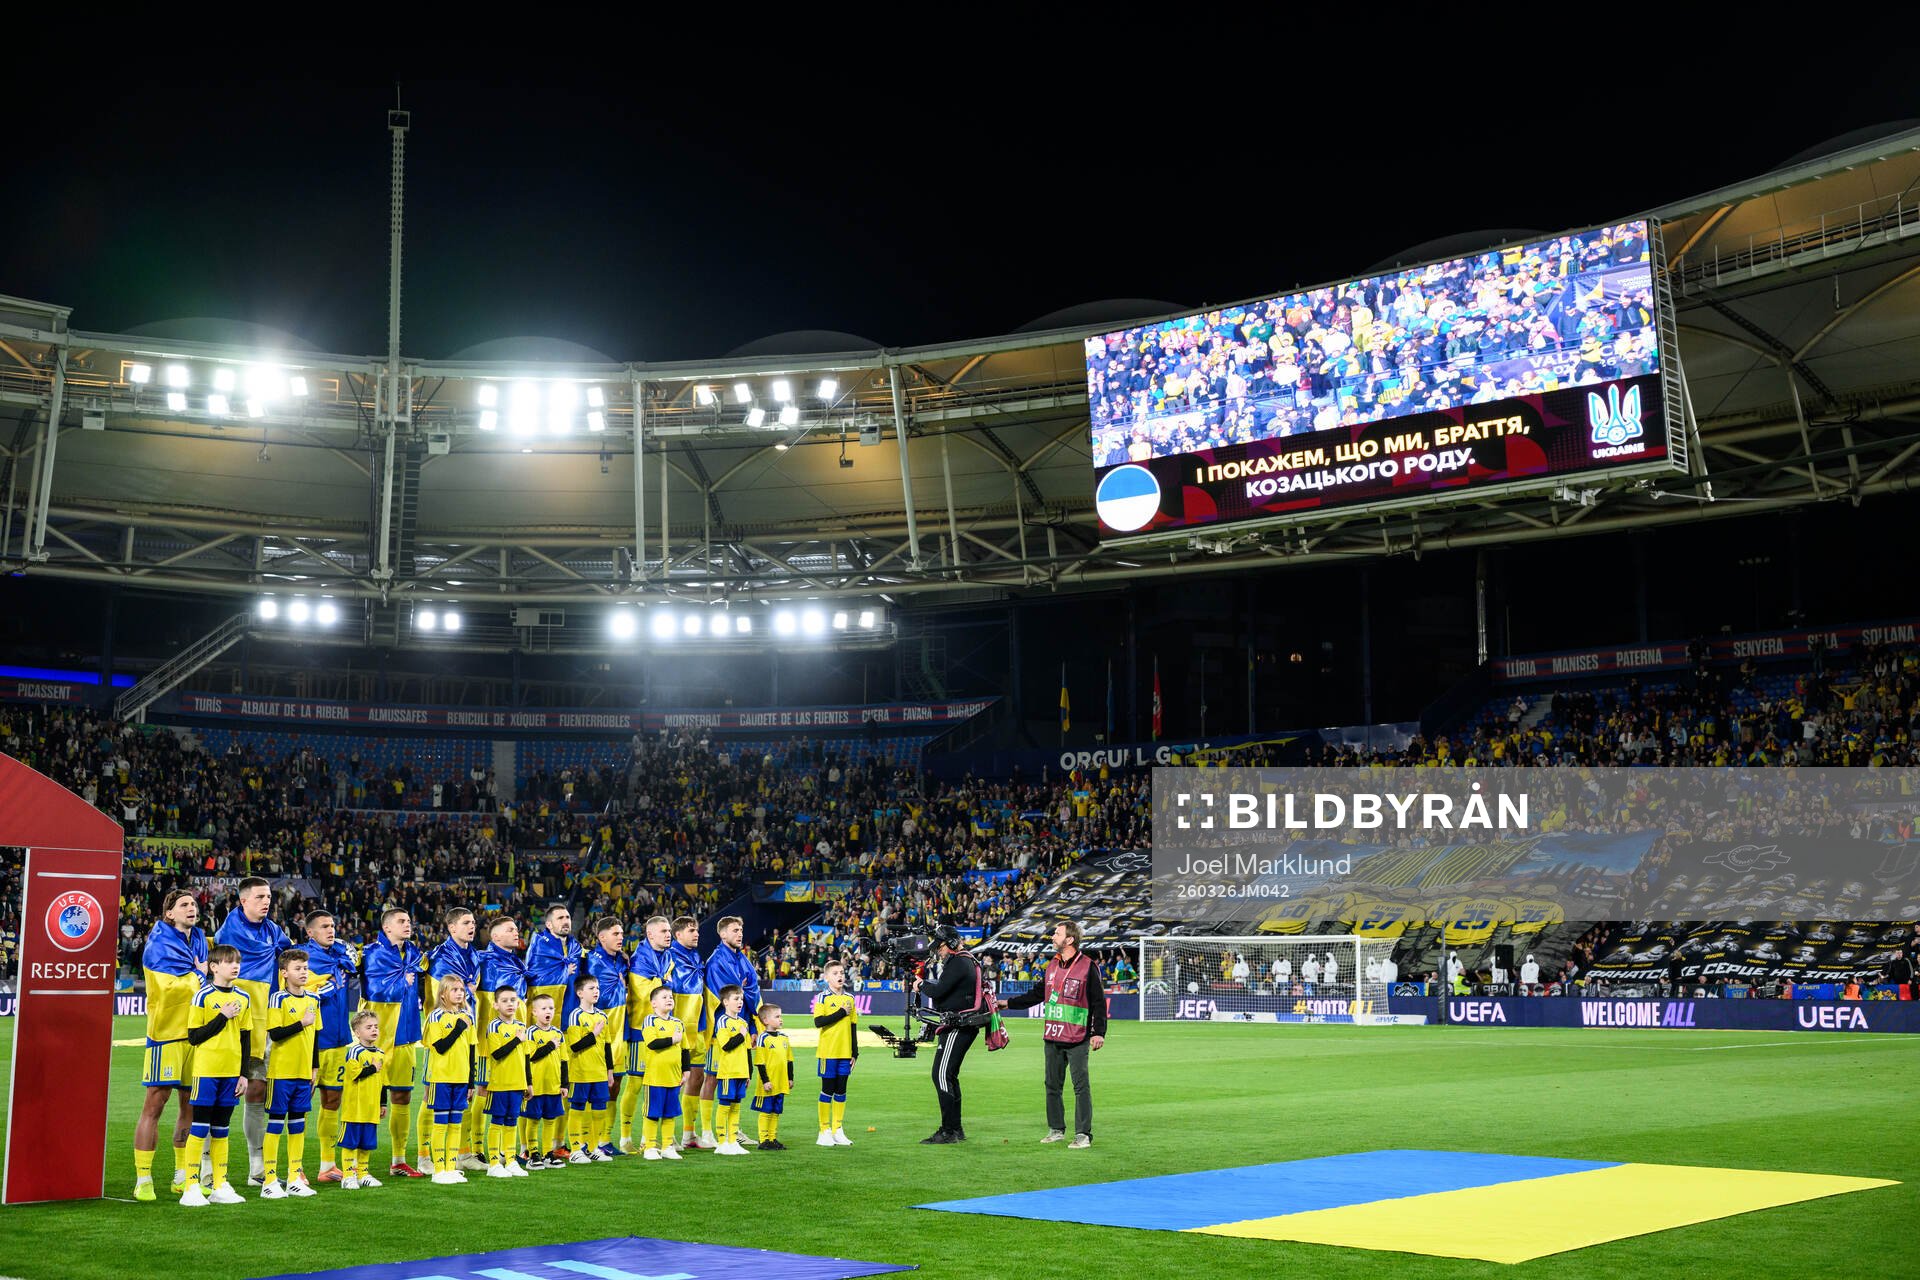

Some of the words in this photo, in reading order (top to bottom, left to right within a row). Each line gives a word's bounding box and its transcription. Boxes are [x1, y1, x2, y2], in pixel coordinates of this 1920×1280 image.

[1208, 448, 1331, 482] ПОКАЖЕМ,
[1335, 440, 1378, 462] ЩО
[1384, 432, 1429, 453] МИ,
[1434, 415, 1530, 446] БРАТТЯ,
[1593, 442, 1645, 459] UKRAINE
[1246, 459, 1399, 498] КОЗАЦЬКОГО
[1404, 447, 1476, 475] РОДУ.
[1733, 637, 1784, 657] SENYERA
[1552, 654, 1599, 674] MANISES
[1616, 648, 1663, 667] PATERNA
[17, 682, 72, 700] PICASSENT
[241, 700, 280, 717] ALBALAT
[284, 703, 296, 718] DE
[300, 704, 311, 719] LA
[315, 705, 349, 720] RIBERA
[368, 708, 428, 724] ALMUSSAFES
[447, 711, 489, 726] BENICULL
[493, 713, 505, 726] DE
[740, 712, 777, 727] CAUDETE
[781, 712, 792, 726] DE
[795, 711, 811, 725] LAS
[814, 710, 849, 725] FUENTES
[559, 714, 631, 728] FUENTERROBLES
[664, 714, 721, 728] MONTSERRAT
[59, 895, 92, 909] UEFA
[1360, 911, 1403, 930] 27
[1454, 910, 1494, 930] 25
[31, 962, 111, 979] RESPECT
[1770, 968, 1800, 977] НЕ
[1048, 1006, 1063, 1018] HB
[1450, 1002, 1507, 1022] UEFA
[1582, 1002, 1660, 1026] WELCOME
[1661, 1002, 1696, 1027] ALL
[1798, 1006, 1868, 1028] UEFA
[1045, 1023, 1064, 1037] 797
